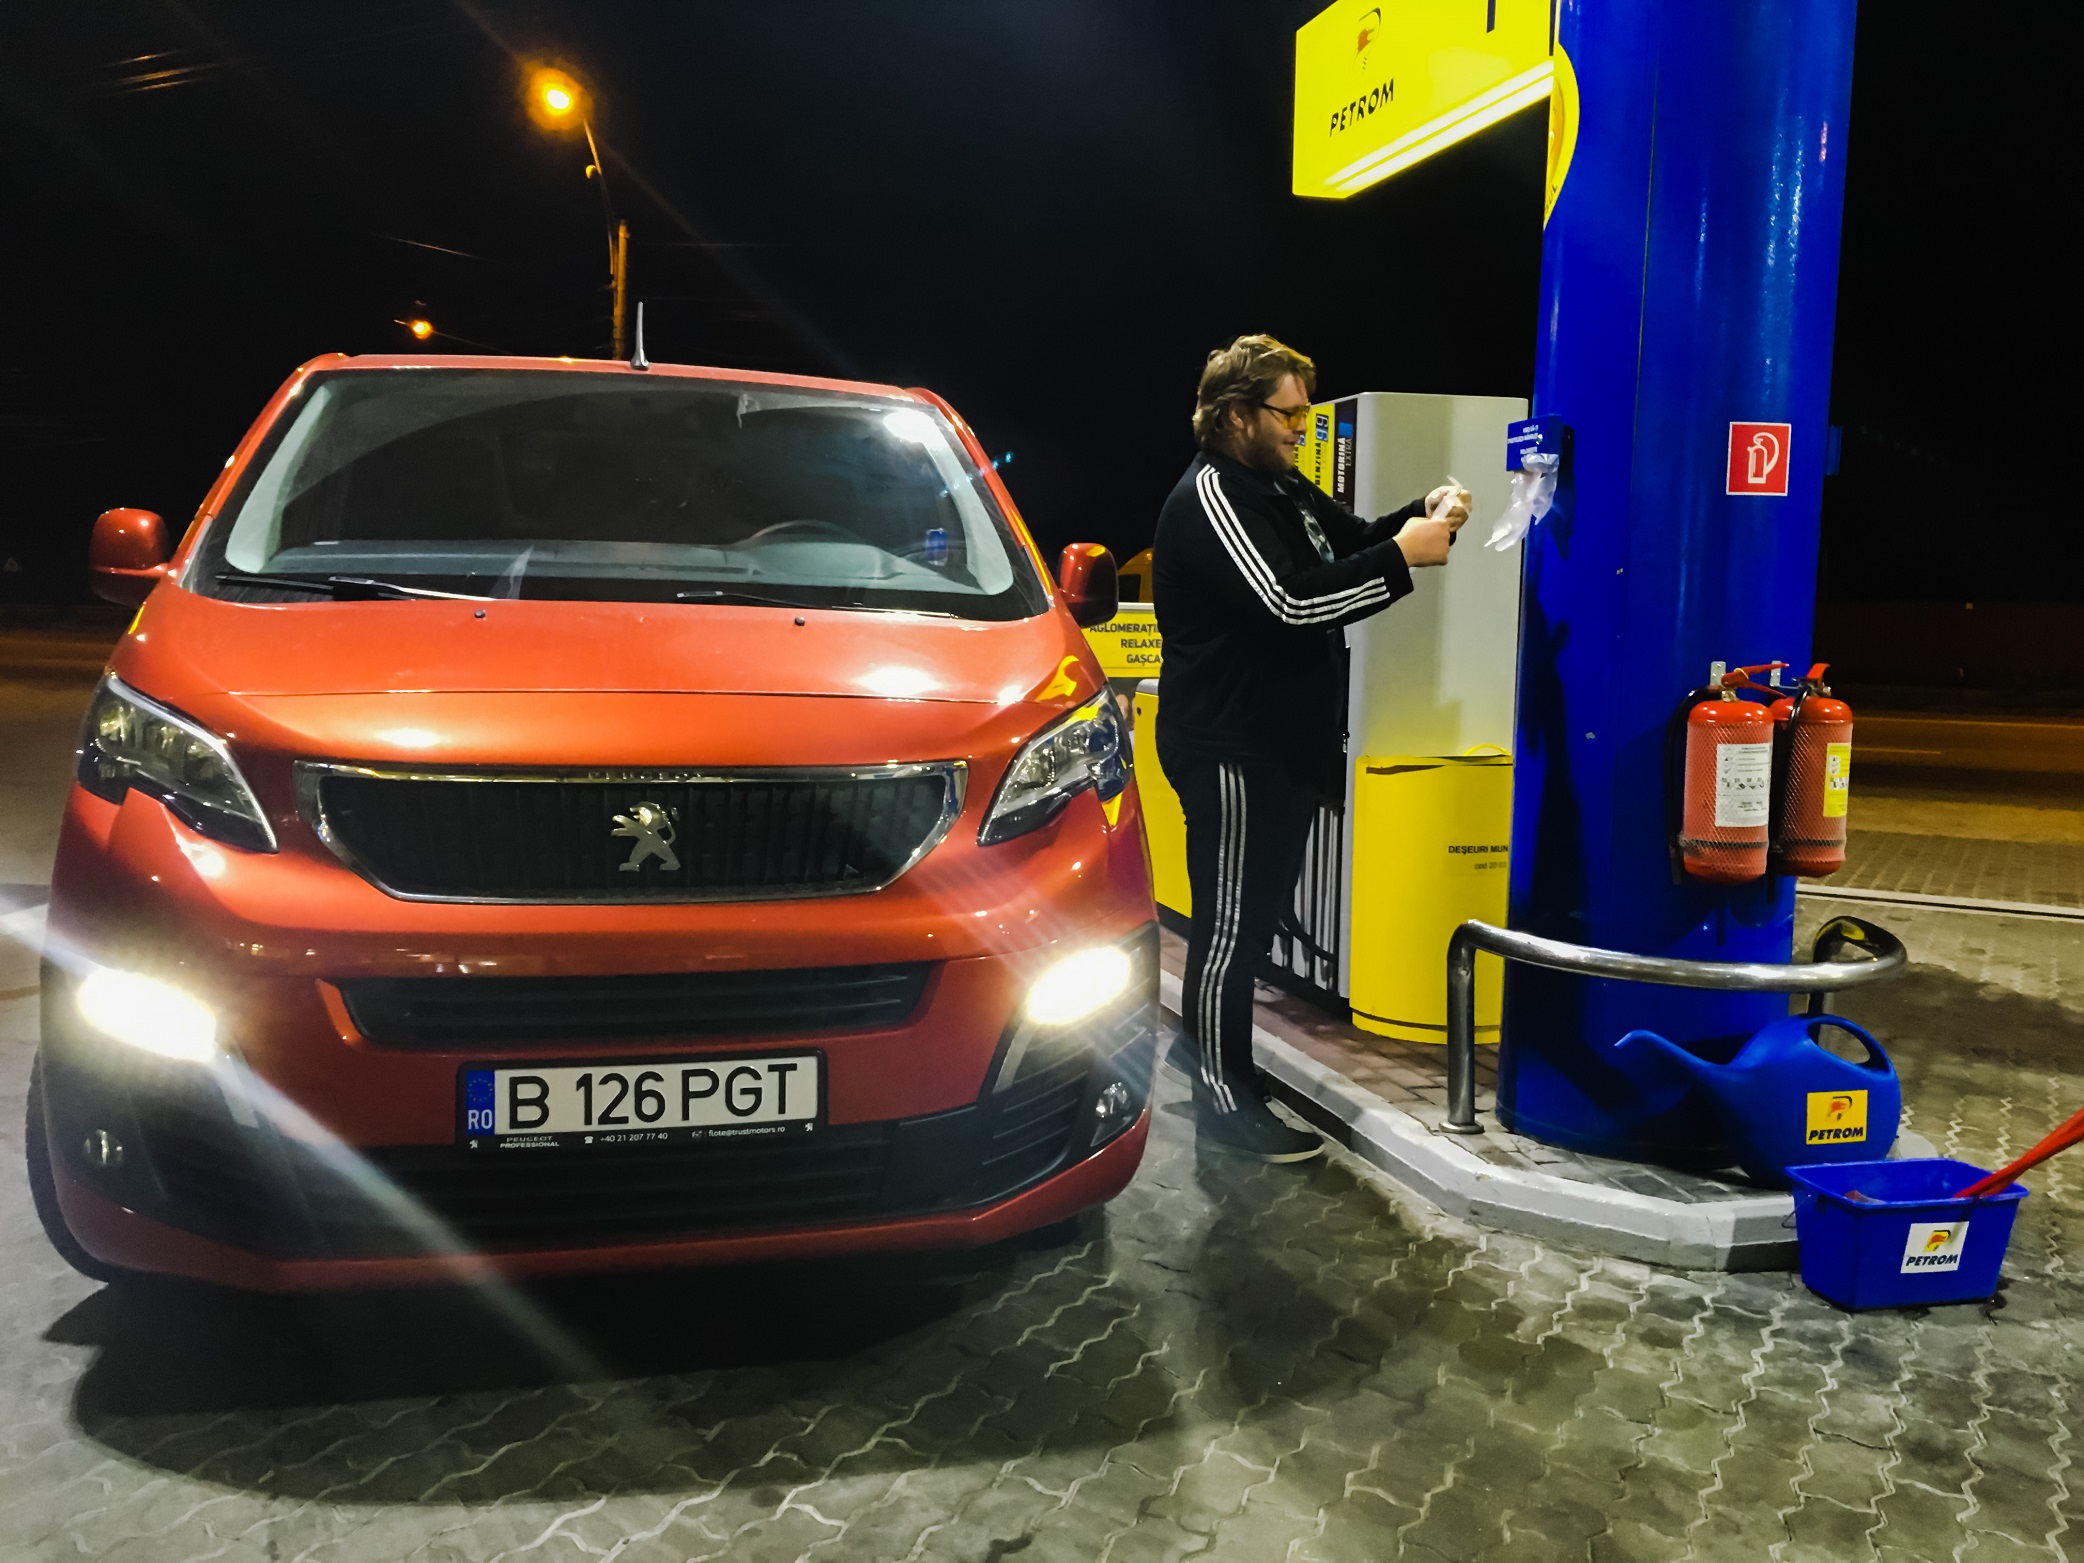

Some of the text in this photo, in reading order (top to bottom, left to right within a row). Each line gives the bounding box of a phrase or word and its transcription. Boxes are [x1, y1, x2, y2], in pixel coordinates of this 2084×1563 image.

[1330, 77, 1394, 137] PETROM
[1337, 437, 1345, 493] MOTORINĂ
[508, 1062, 798, 1130] B 126 PGT
[468, 1109, 493, 1130] RO
[600, 1132, 668, 1143] +40 21 207 77 40
[1808, 1126, 1864, 1141] PETROM
[500, 1141, 560, 1149] PROFESSIONAL
[1905, 1254, 1959, 1266] PETROM
